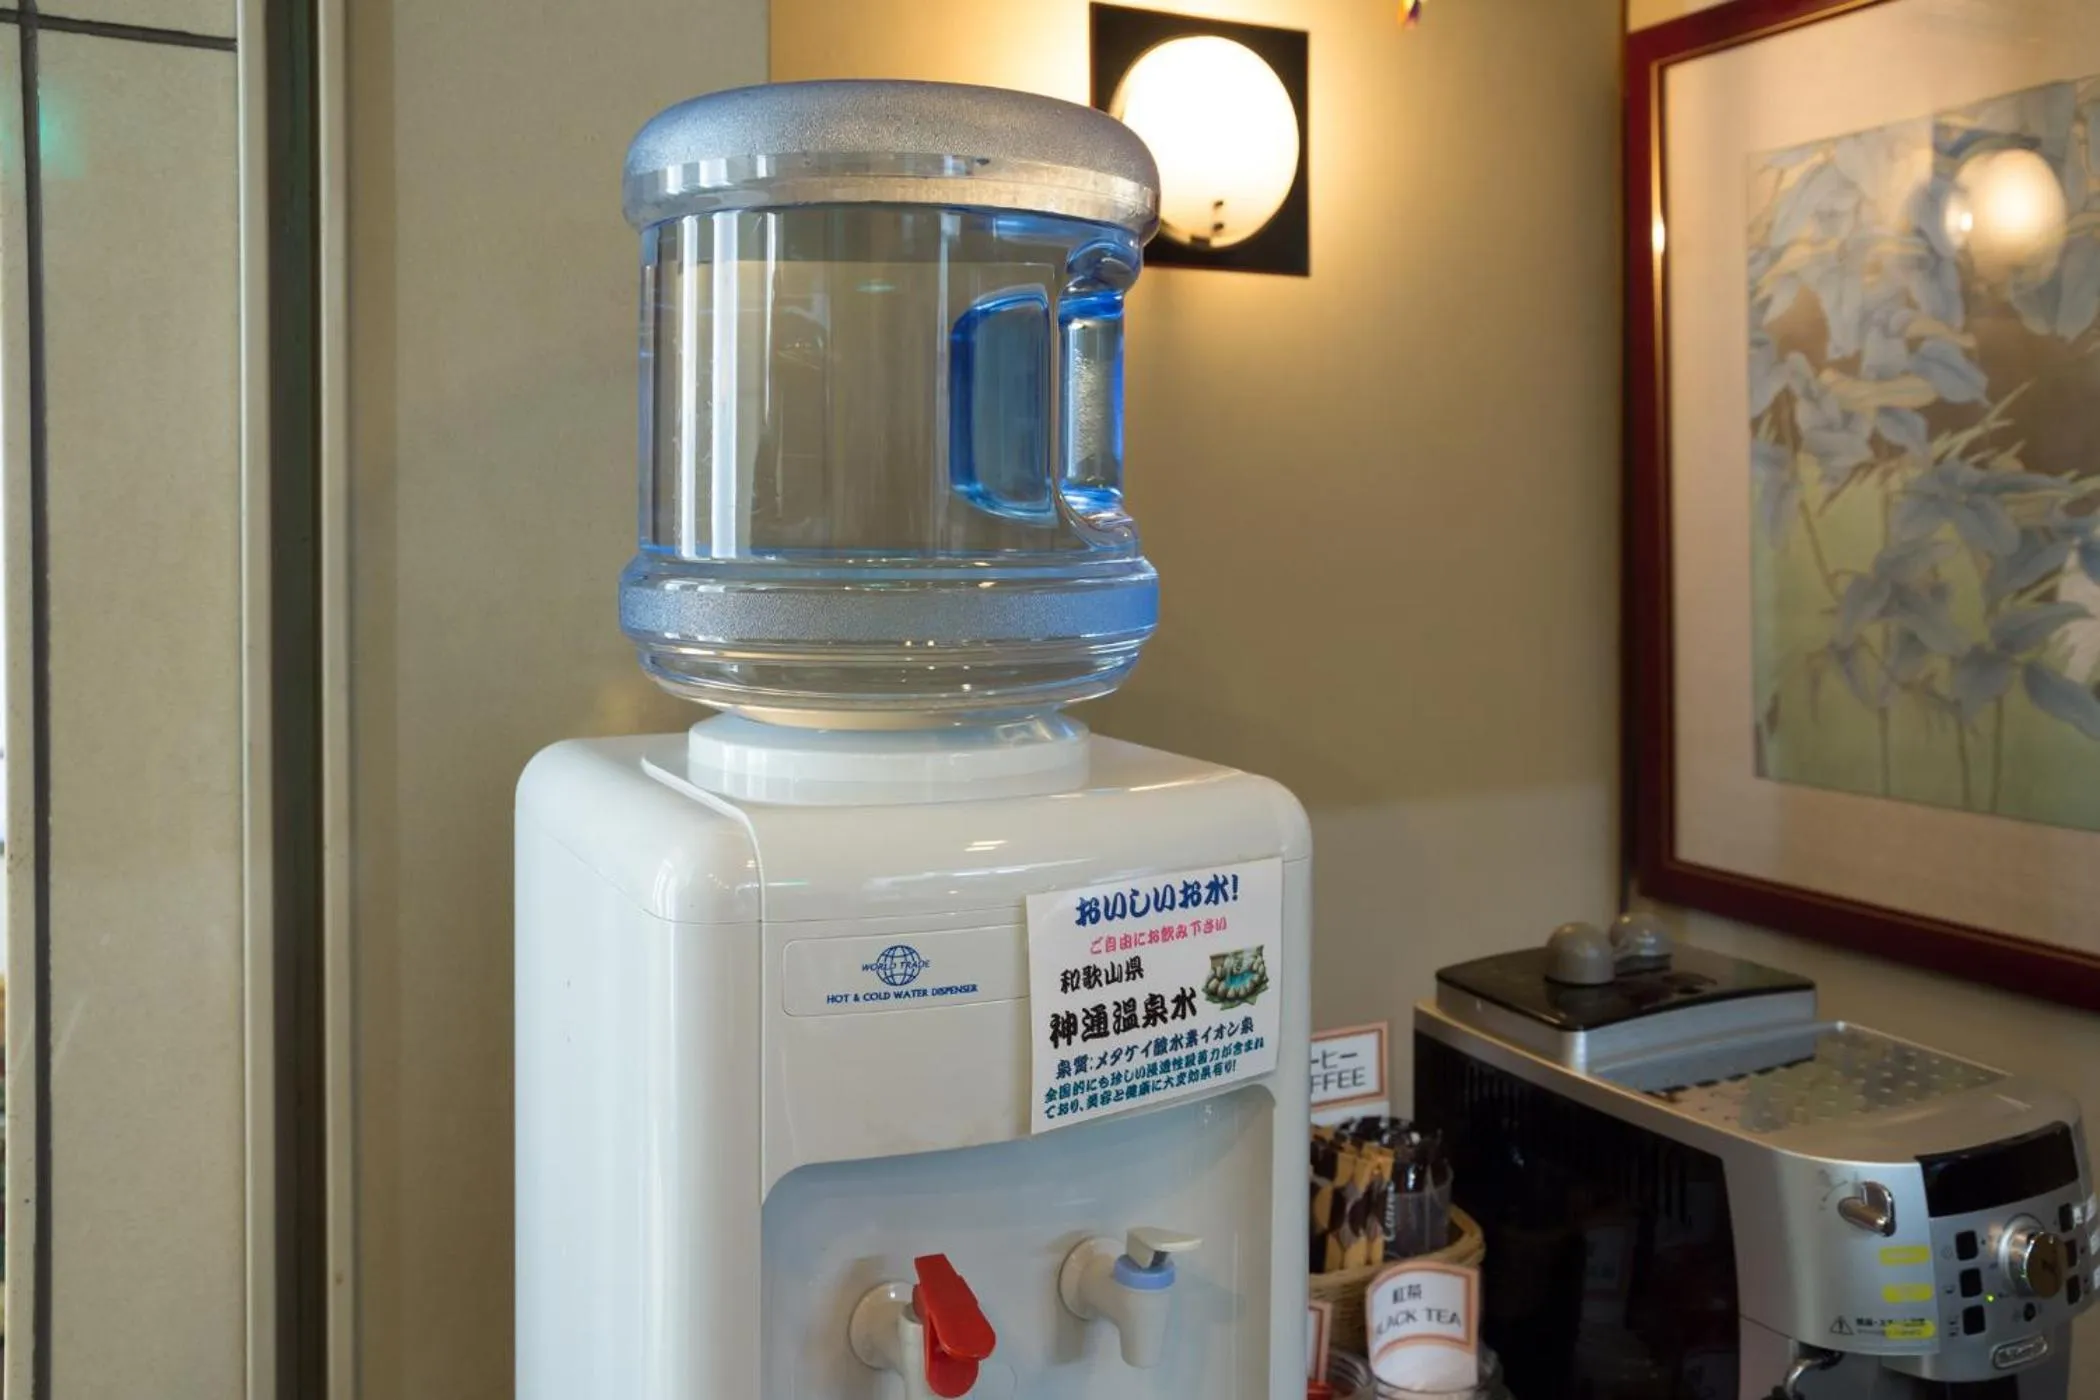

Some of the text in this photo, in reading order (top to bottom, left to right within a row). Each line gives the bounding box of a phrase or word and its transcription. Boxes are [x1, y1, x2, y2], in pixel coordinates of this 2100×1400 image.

[1075, 873, 1239, 927] おいしいお水!
[1090, 916, 1228, 955] ご自由にお飲み下さい
[862, 959, 931, 972] WORLD TRADE
[1060, 956, 1145, 994] 和歌山県
[826, 983, 979, 1004] HOT & COLD WATER DISPENSER
[1049, 986, 1197, 1049] 神通温泉水
[1310, 1066, 1366, 1094] FFEE
[1423, 1307, 1463, 1328] TEA
